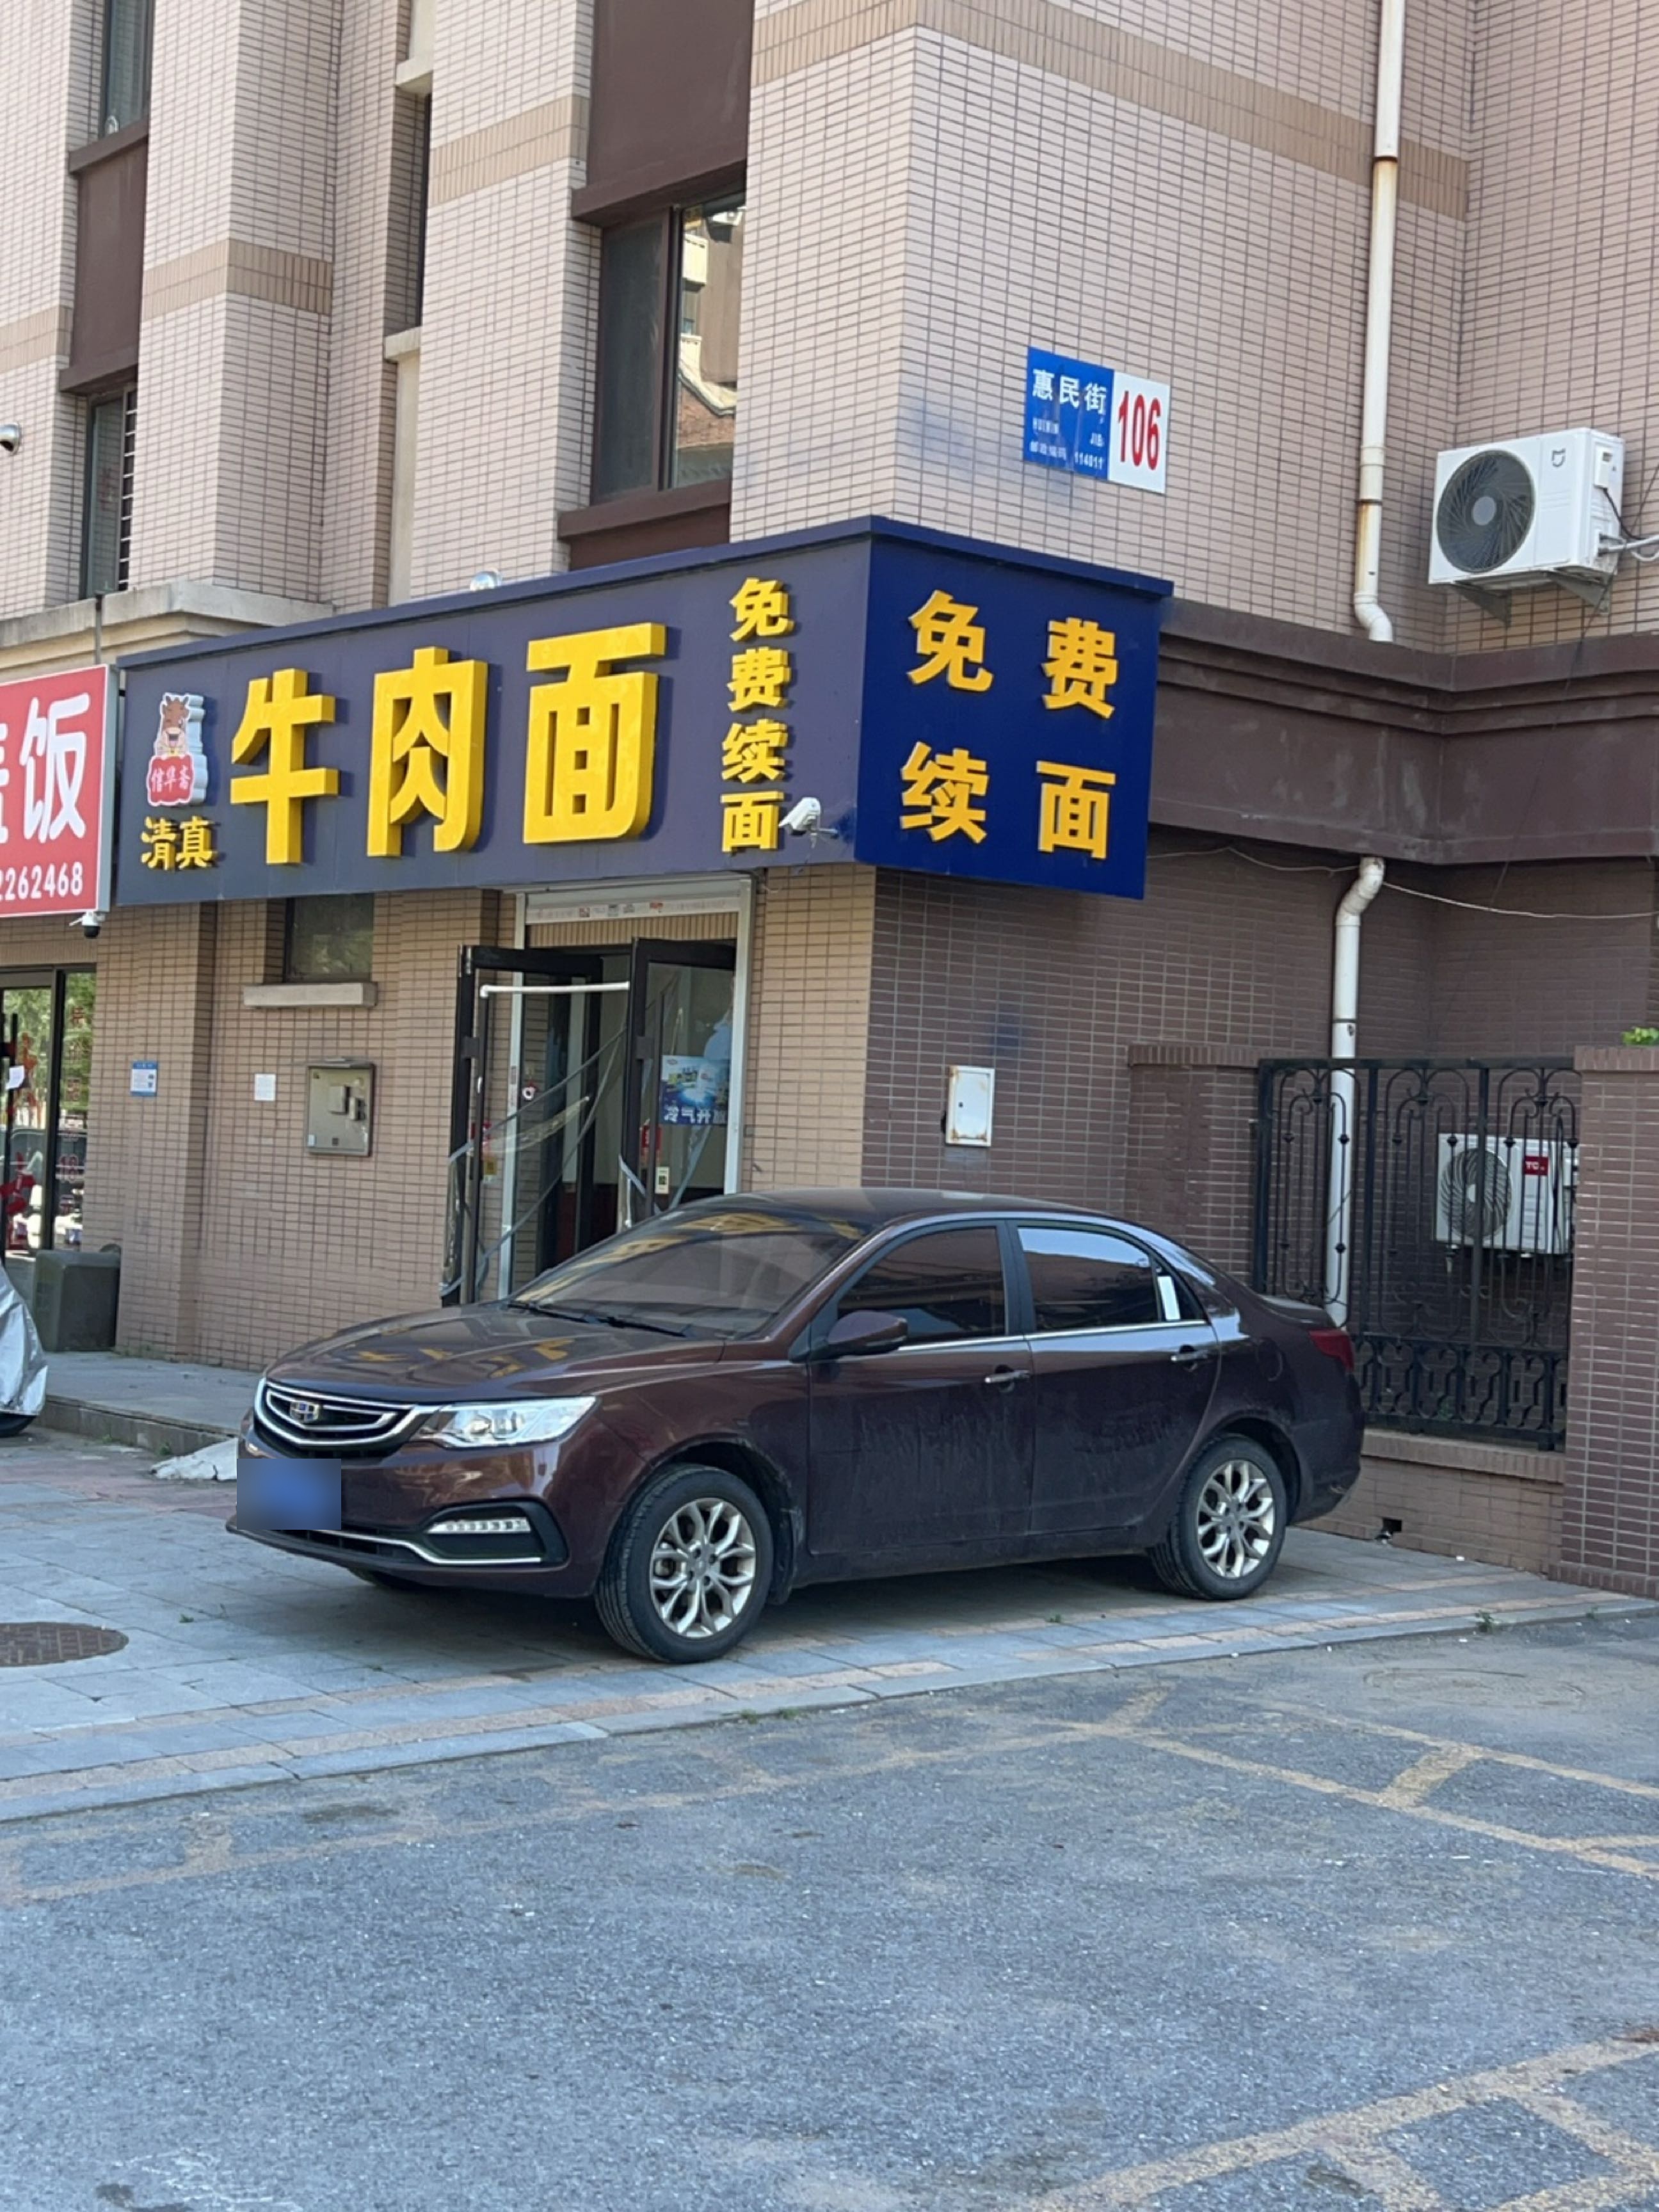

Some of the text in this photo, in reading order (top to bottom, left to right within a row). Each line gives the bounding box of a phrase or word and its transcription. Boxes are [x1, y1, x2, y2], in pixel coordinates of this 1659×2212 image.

[1032, 367, 1107, 415] 惠民街
[1118, 390, 1161, 471] 106
[721, 577, 794, 853] 免费续面
[908, 589, 1119, 719] 免费
[0, 692, 90, 844] 饭
[230, 622, 666, 865] 牛肉面
[901, 742, 1116, 860] 续面
[141, 816, 215, 870] 清真
